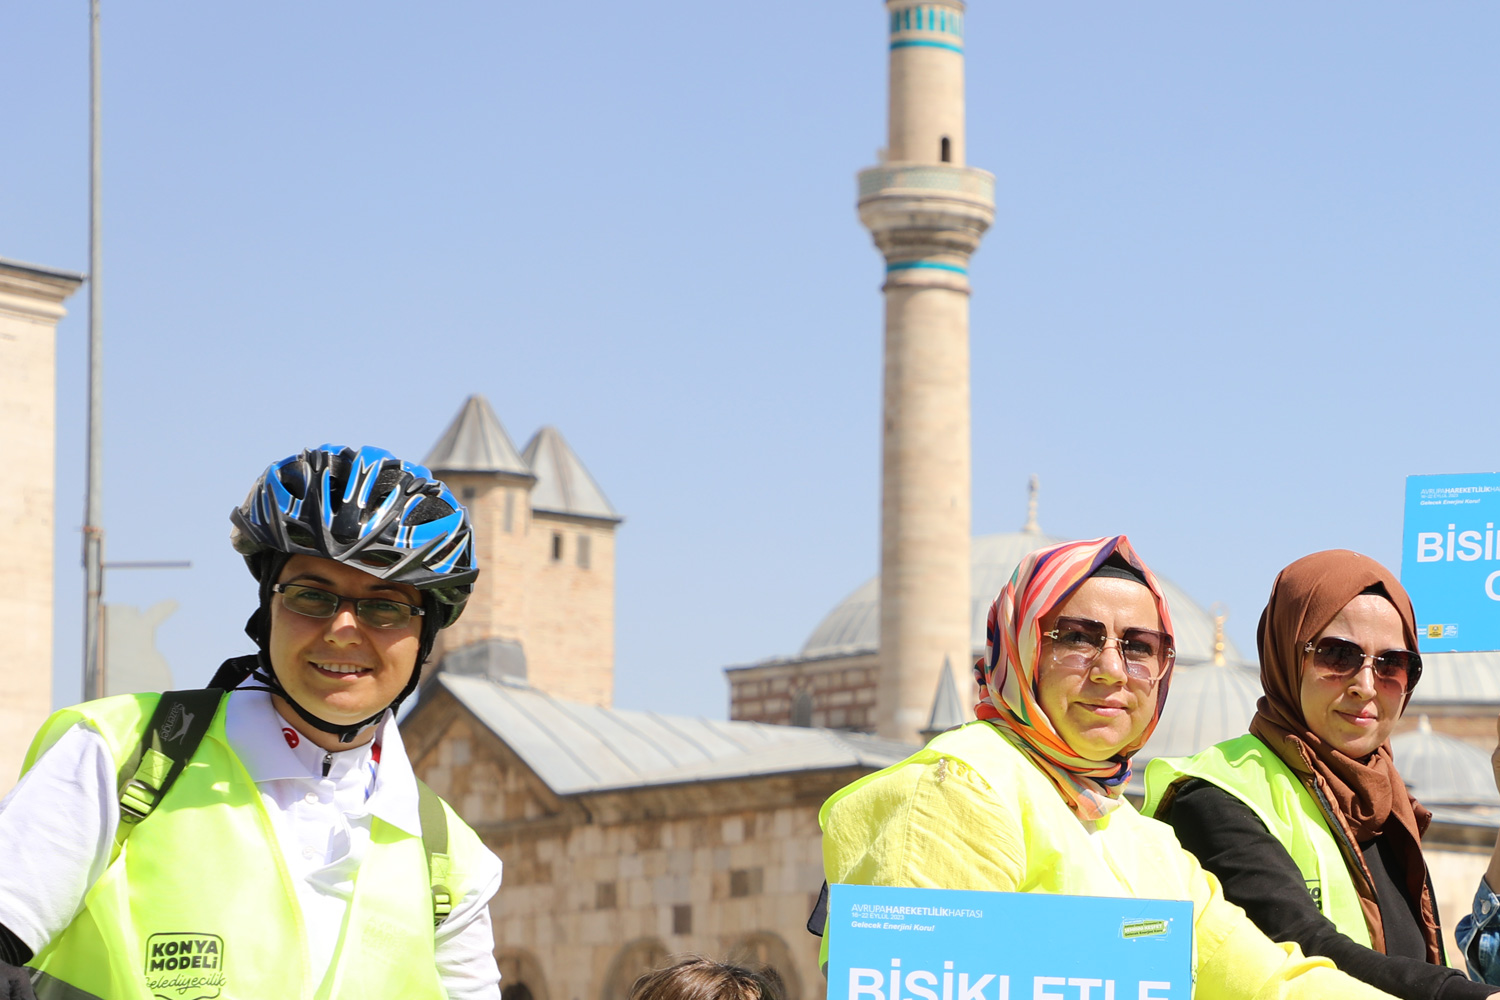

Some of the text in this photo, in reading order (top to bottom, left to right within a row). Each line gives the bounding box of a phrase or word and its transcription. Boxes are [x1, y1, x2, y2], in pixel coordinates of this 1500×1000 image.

[850, 920, 936, 932] Gelecek Enerjini Koru!
[151, 939, 219, 958] KONYA
